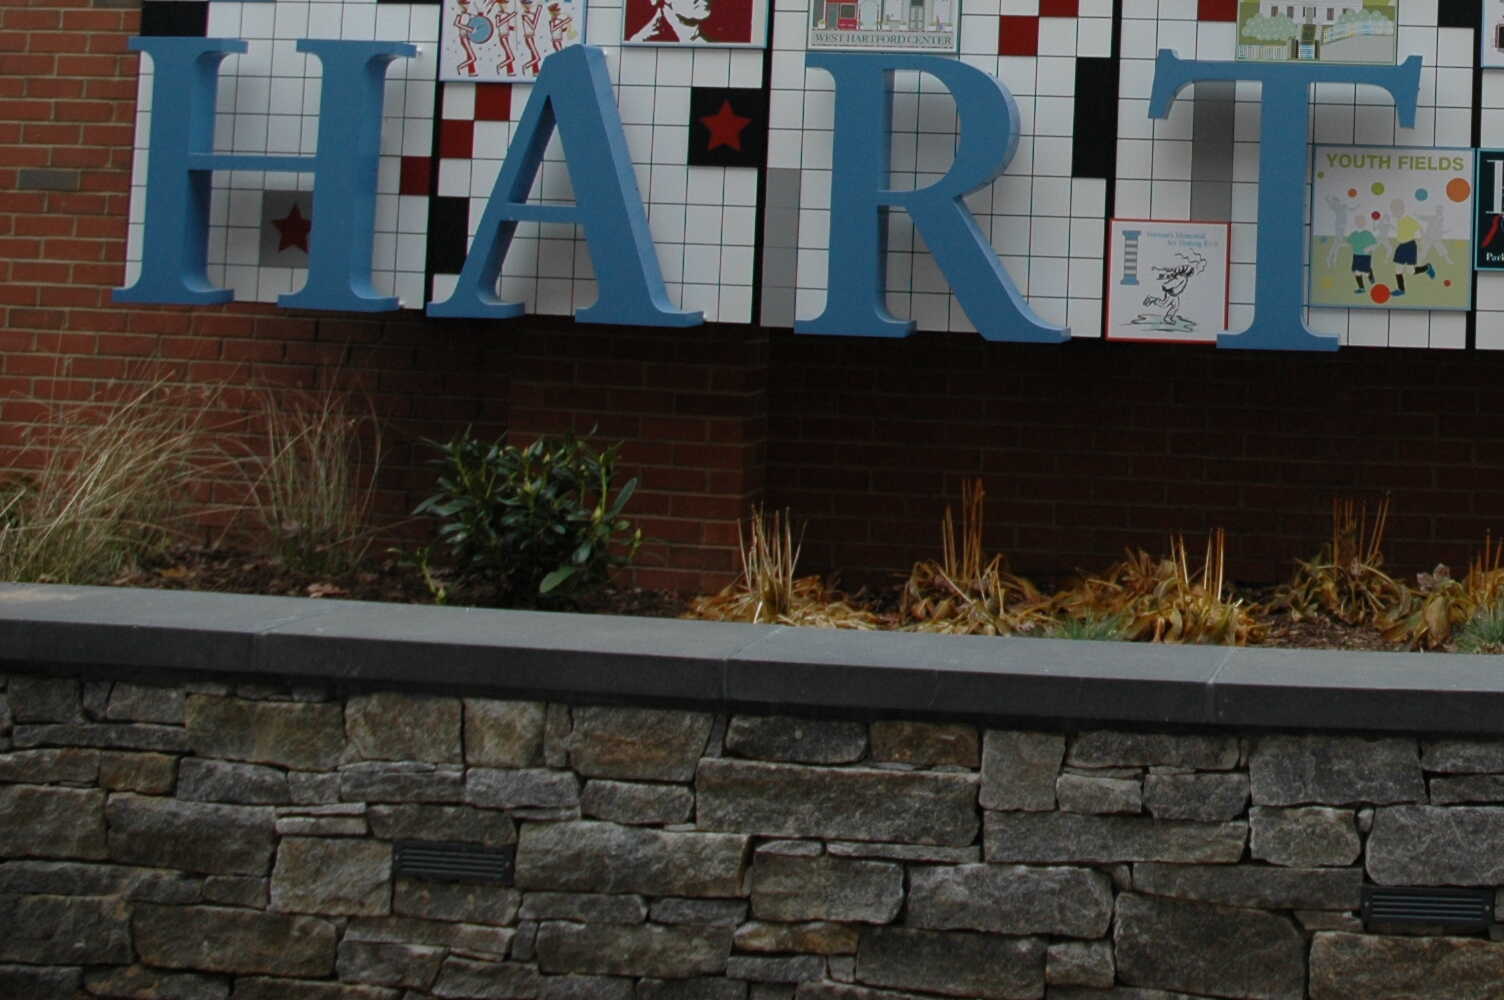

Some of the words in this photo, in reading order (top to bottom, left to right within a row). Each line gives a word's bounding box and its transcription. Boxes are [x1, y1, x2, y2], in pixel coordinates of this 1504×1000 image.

[814, 32, 844, 44] WEST
[845, 33, 907, 46] HARTFORD
[907, 35, 953, 48] CENTER
[1325, 153, 1392, 170] YOUTH
[1397, 155, 1465, 172] FIELDS
